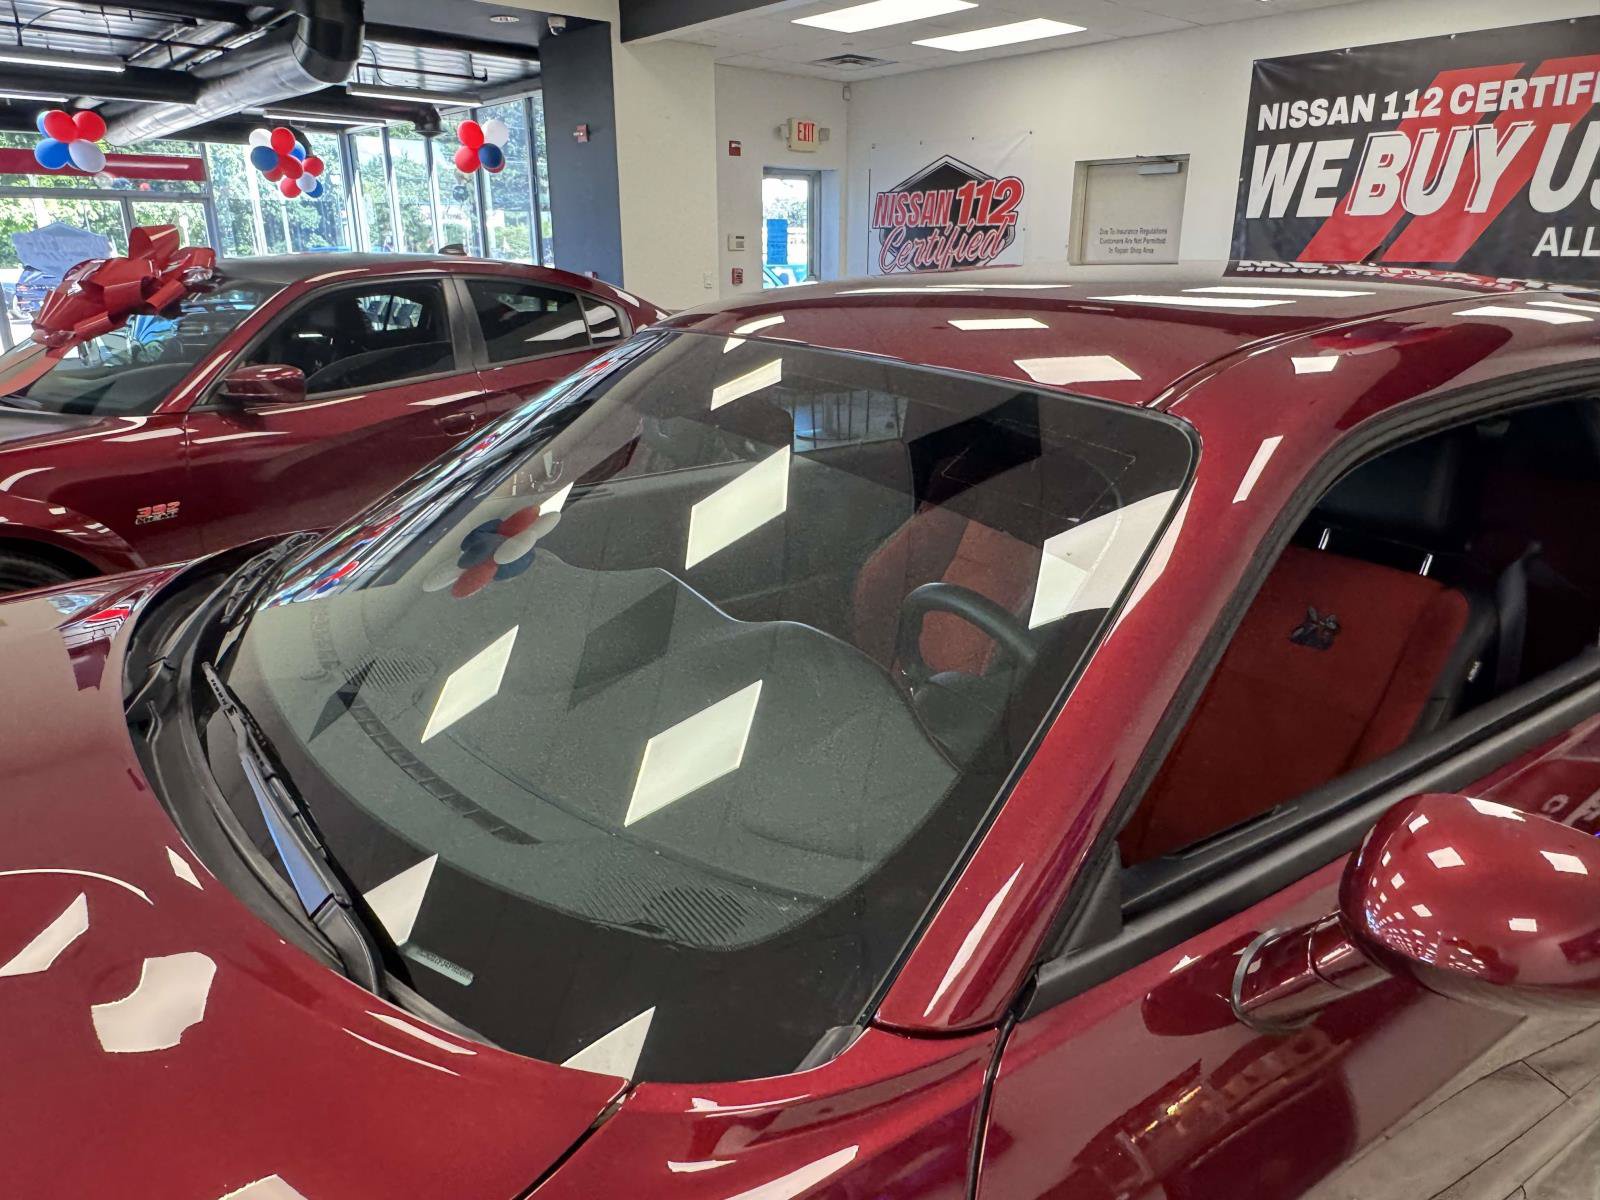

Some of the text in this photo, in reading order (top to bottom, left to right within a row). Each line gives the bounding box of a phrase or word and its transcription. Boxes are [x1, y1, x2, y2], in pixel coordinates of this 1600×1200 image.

[797, 121, 815, 142] EXIT
[1258, 94, 1375, 131] NISSAN
[1381, 87, 1443, 121] 112
[1246, 121, 1600, 218] WE BUY U
[873, 176, 1024, 229] NISSAN 112
[879, 216, 1007, 274] Certified
[1532, 227, 1600, 257] ALL
